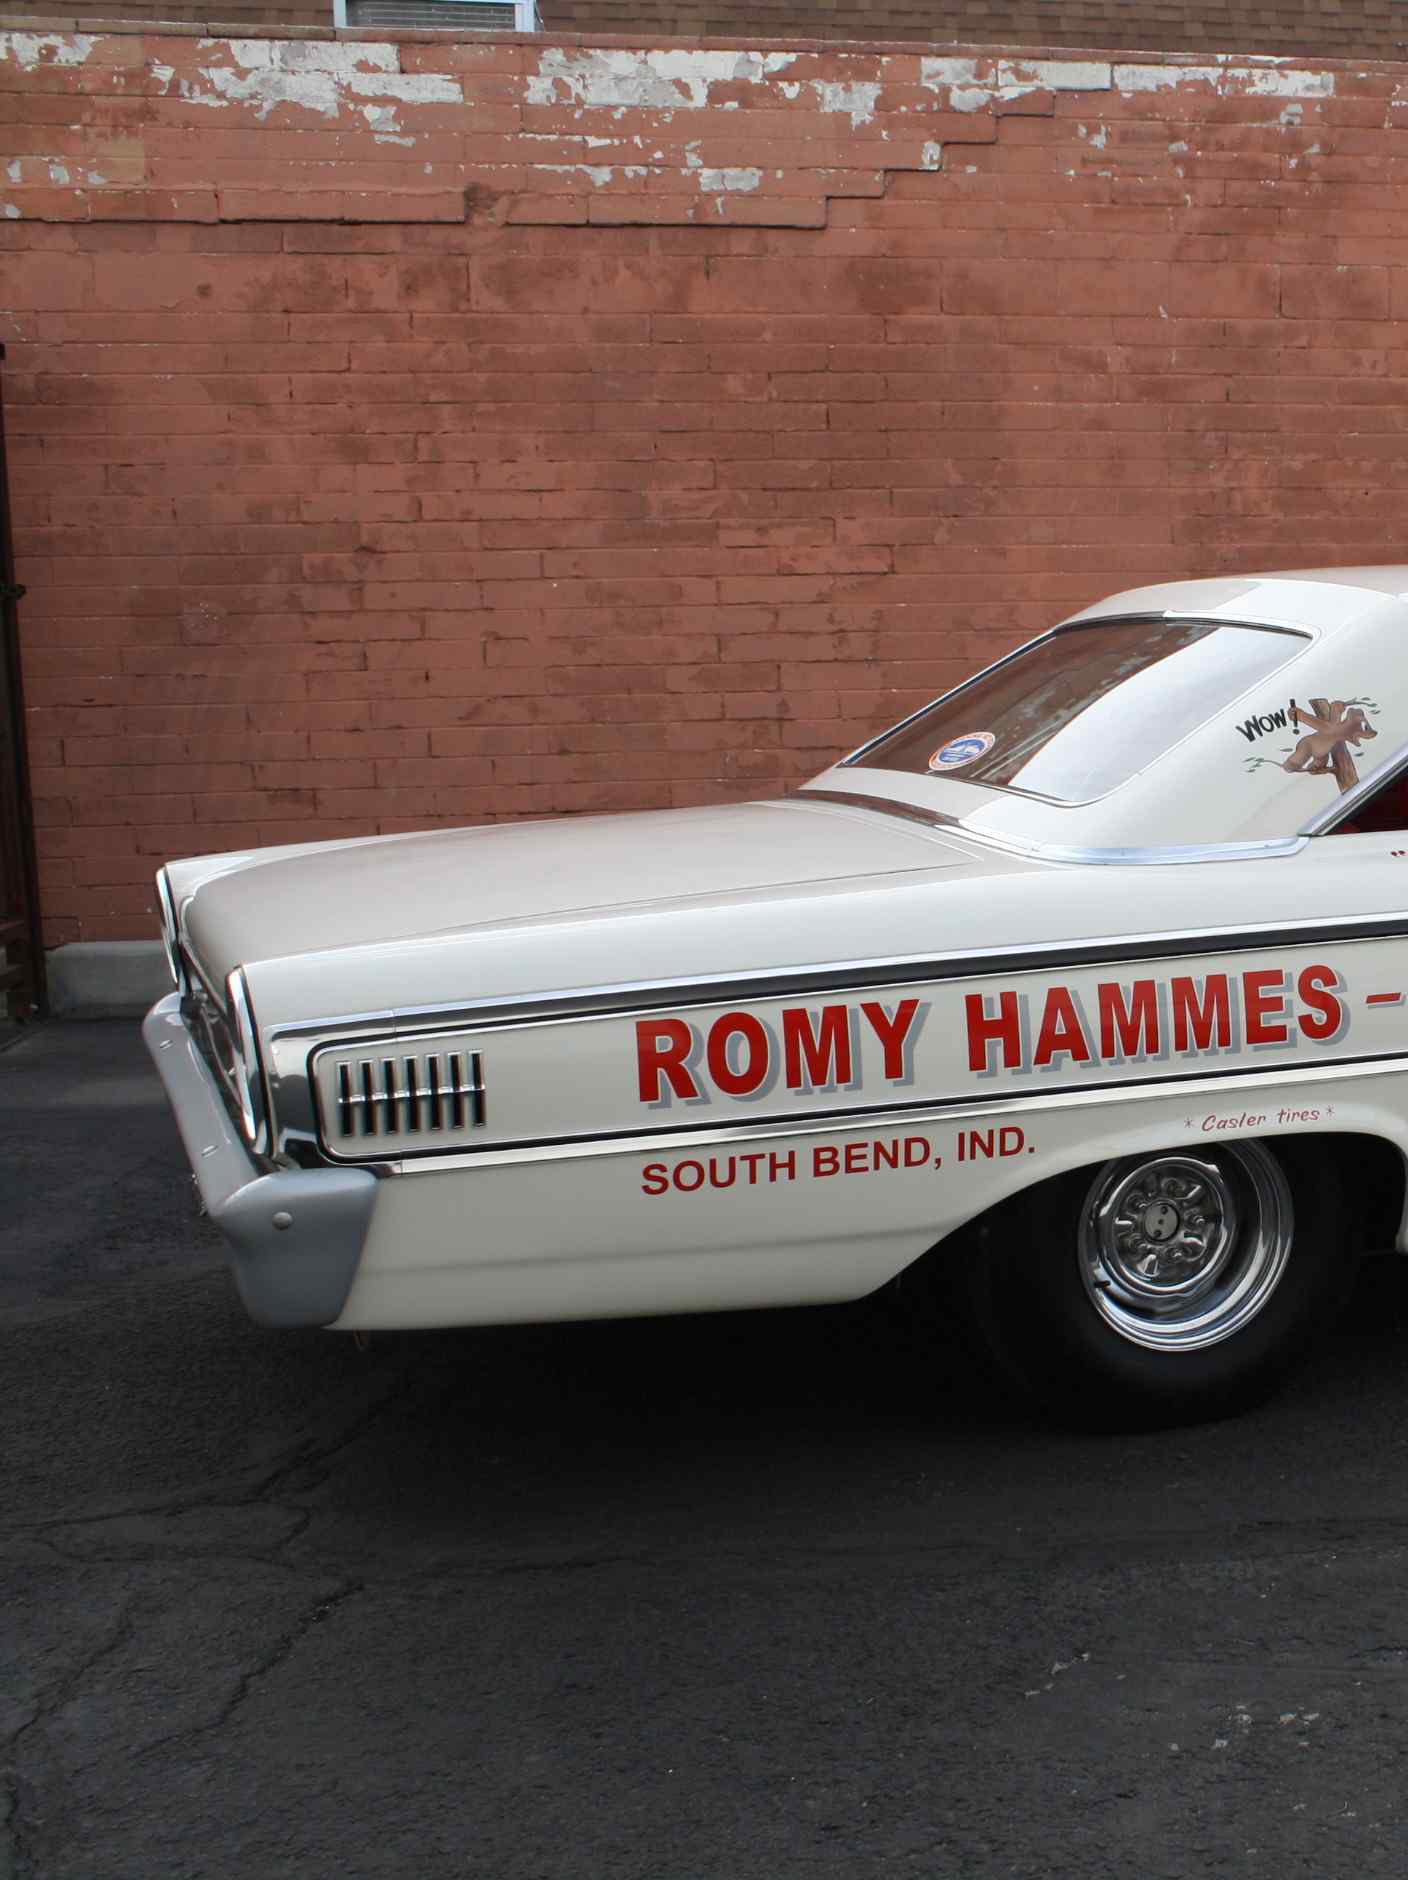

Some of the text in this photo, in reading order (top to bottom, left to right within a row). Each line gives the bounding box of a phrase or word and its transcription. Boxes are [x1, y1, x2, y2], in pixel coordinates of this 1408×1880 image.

[636, 997, 926, 1105] ROMY
[963, 963, 1345, 1075] HAMMES
[1201, 1107, 1321, 1132] Casler tires
[641, 1124, 1036, 1196] SOUTH BEND, IND.
